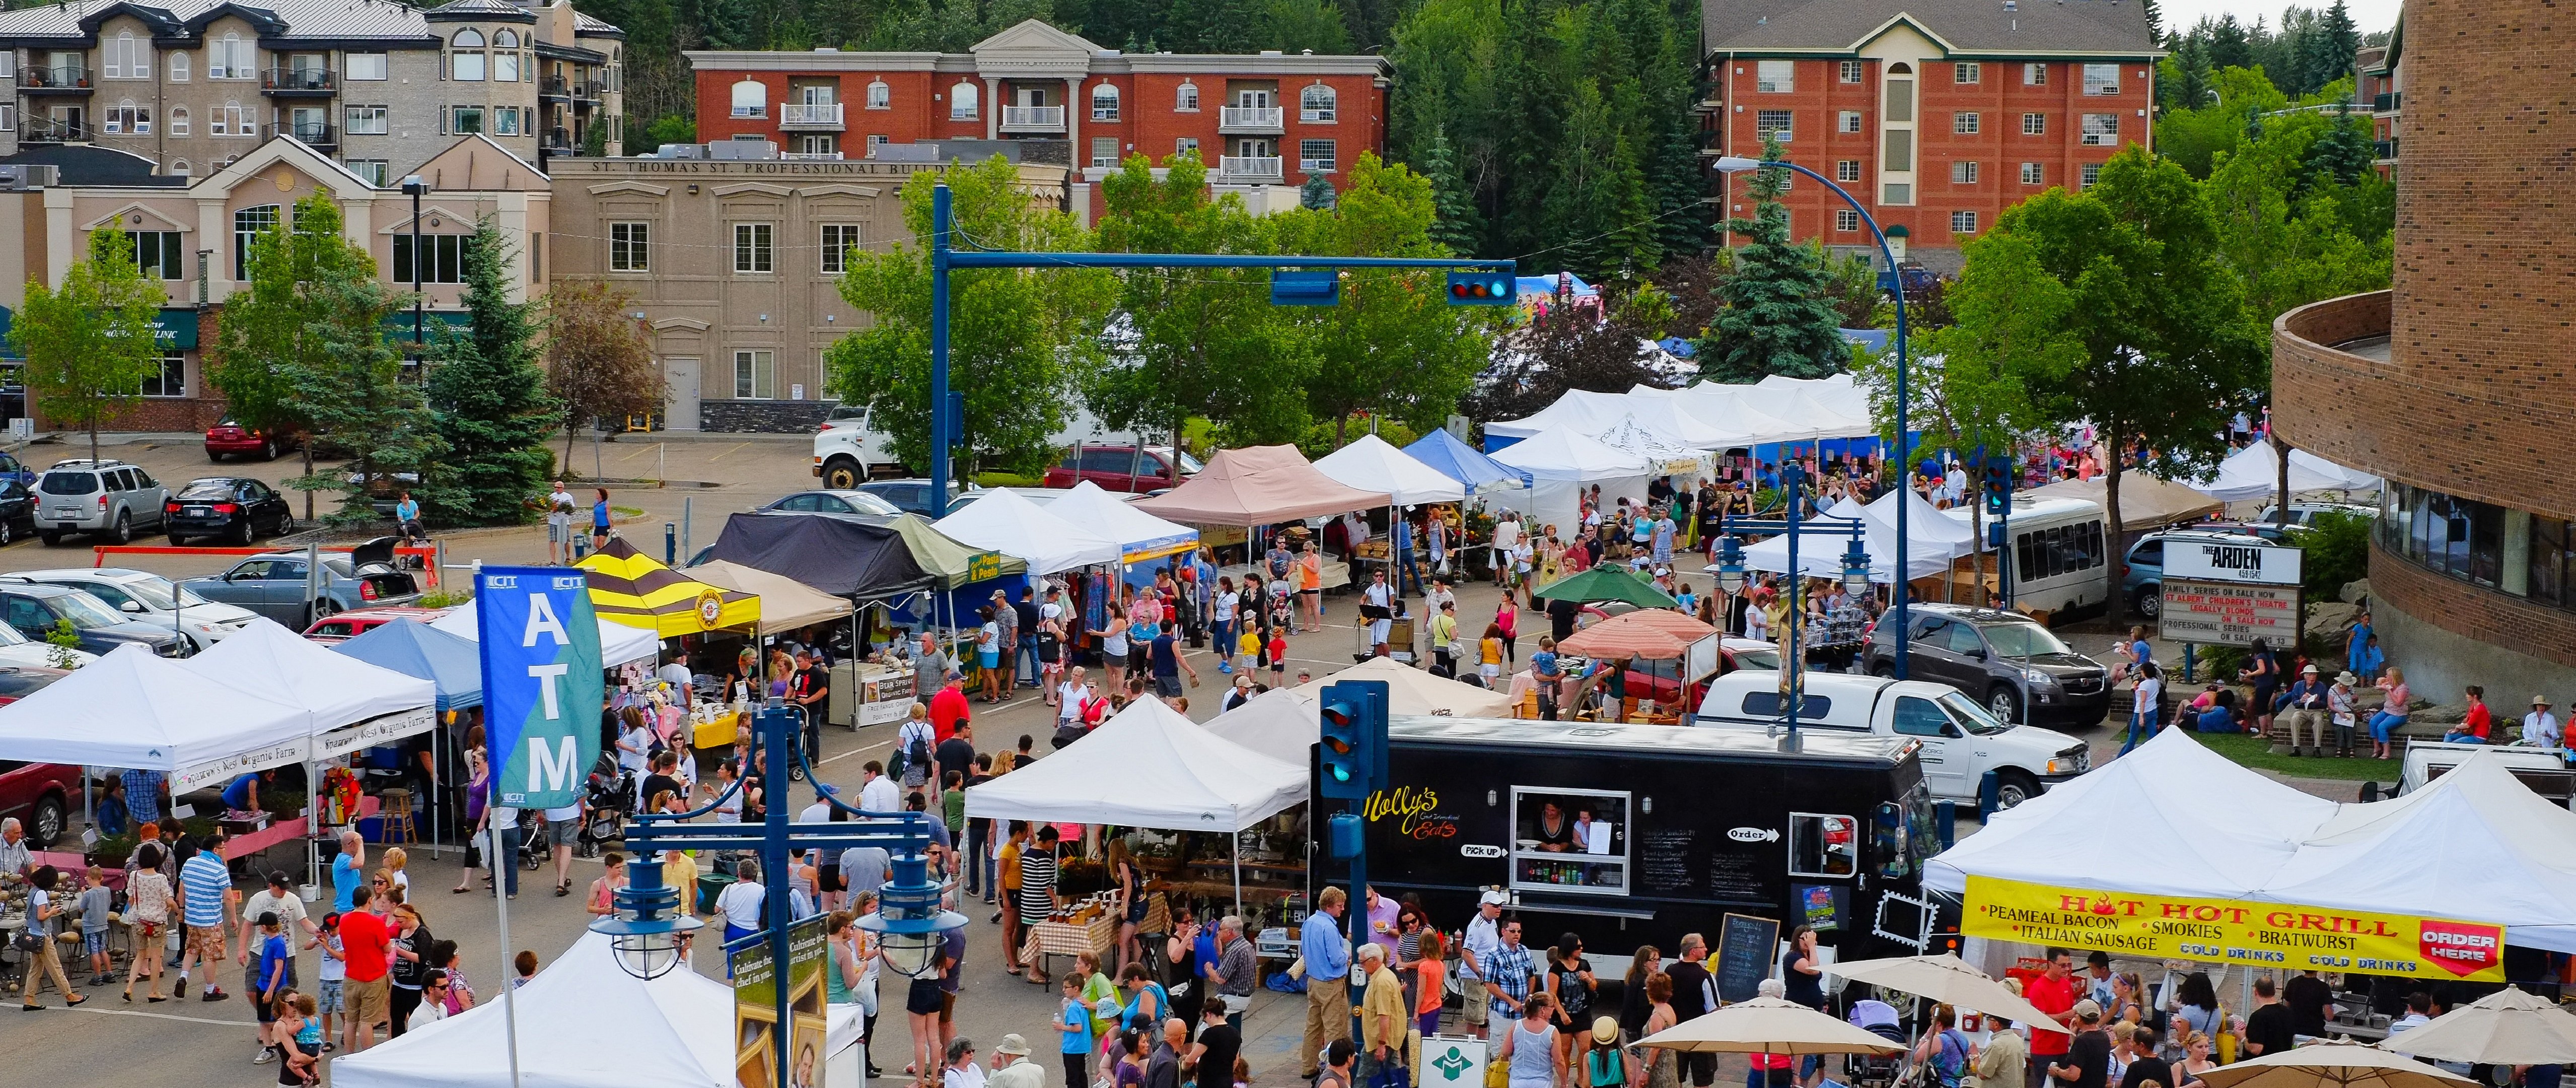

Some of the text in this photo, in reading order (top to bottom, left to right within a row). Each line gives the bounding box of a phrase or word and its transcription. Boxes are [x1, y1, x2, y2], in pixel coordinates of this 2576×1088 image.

[592, 162, 978, 174] ST. THOMAS ST. PROFESSIONAL BUILDG
[982, 554, 999, 566] Pasta
[2202, 545, 2261, 570] THE ARDEN
[971, 566, 997, 581] & Pesto
[2239, 569, 2261, 579] 459-1542
[2165, 585, 2190, 593] FAMILY
[2194, 586, 2219, 595] SERIES
[2236, 589, 2254, 597] SALE
[2177, 595, 2204, 603] ALBERT
[2209, 597, 2251, 606] CHILDREN'S
[2256, 599, 2287, 608] THEATRE
[2190, 604, 2255, 616] LEGALLY BLONDE
[2164, 621, 2250, 633] PROFESSIONAL SERIES
[2237, 617, 2256, 625] SALE
[523, 592, 578, 792] ATM
[880, 682, 894, 690] BEAR
[881, 691, 901, 699] ORGANIC
[325, 716, 425, 753] Sparrow's Nest Organic Farm
[223, 760, 237, 772] Nest
[241, 750, 273, 769] Organic
[275, 747, 296, 759] Farm
[1413, 821, 1457, 840] Eats
[1731, 830, 1764, 839] Order
[1989, 904, 2357, 950] PEAMEAL BACON SMOKIES BRATWURST
[2160, 903, 2250, 924] HOT
[2266, 911, 2398, 938] GRILL
[789, 933, 826, 953] Cultivate the
[2021, 925, 2157, 951] ITALIAN SAUSAGE
[2422, 930, 2495, 948] ORDER
[790, 946, 825, 965] artist in you.
[2180, 943, 2285, 963] COLD DRINKS
[2431, 947, 2486, 962] HERE
[735, 955, 773, 975] Cultivate the
[2309, 955, 2417, 972] COLD DRINKS
[736, 970, 772, 988] chef in you.
